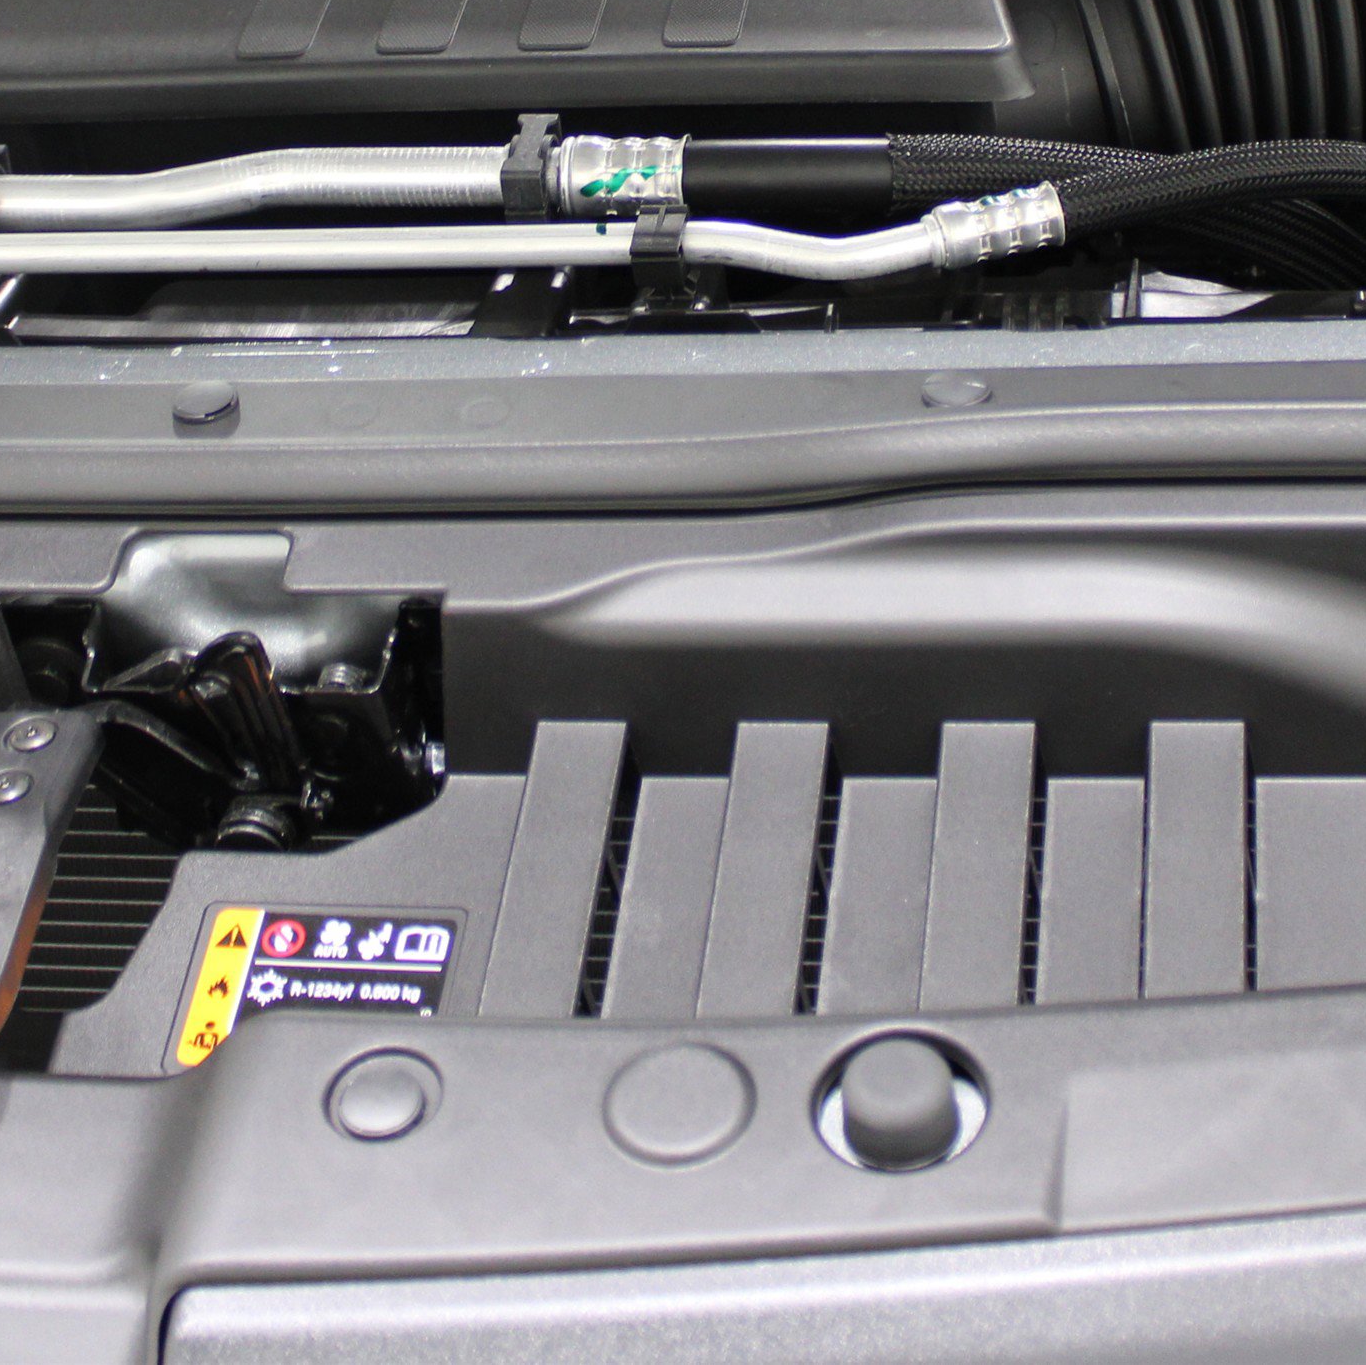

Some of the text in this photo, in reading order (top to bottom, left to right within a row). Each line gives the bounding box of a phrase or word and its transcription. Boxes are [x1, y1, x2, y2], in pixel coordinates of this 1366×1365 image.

[313, 943, 349, 959] AUTO
[290, 979, 355, 1002] R-1234yf
[401, 983, 422, 1005] kg
